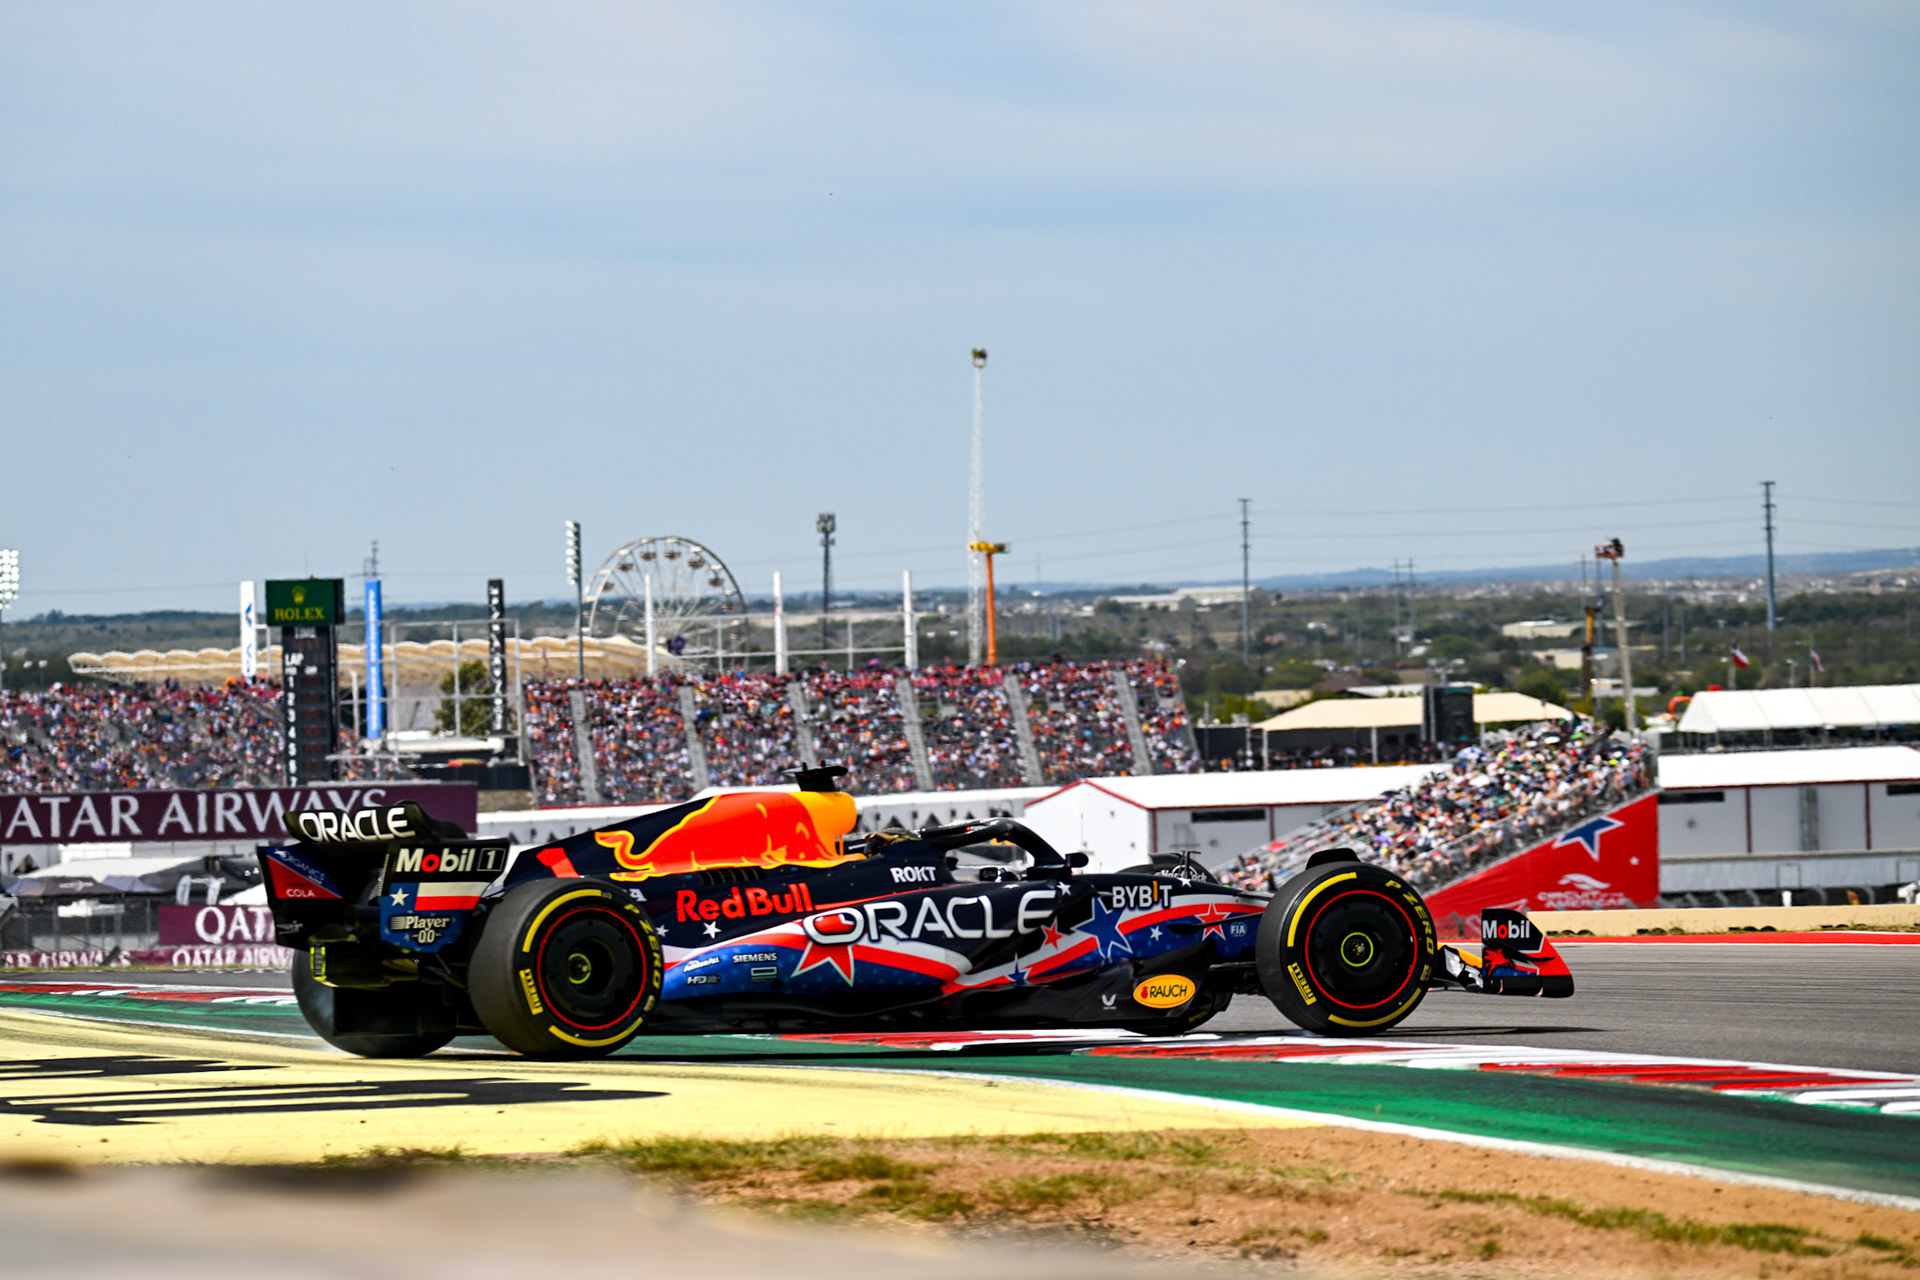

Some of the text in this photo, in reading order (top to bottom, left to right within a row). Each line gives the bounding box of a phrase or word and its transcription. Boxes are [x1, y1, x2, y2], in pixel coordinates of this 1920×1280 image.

[274, 607, 325, 621] ROLEX
[285, 652, 304, 666] LAP
[288, 726, 296, 739] 4
[0, 794, 142, 839] ATAR
[298, 807, 416, 842] ORACLE
[395, 847, 496, 873] Mobil 1
[890, 866, 937, 883] ROKT
[286, 888, 316, 898] COLA
[676, 882, 814, 922] Red Bull
[1112, 880, 1173, 908] BYBIT
[404, 916, 451, 930] Player
[803, 889, 1057, 944] ORACLE
[1385, 880, 1402, 889] P
[1402, 892, 1435, 956] ZERO
[1481, 919, 1530, 939] Mobil
[624, 903, 640, 914] P
[638, 919, 662, 990] ZERO
[732, 952, 778, 963] SIEMENS
[1149, 984, 1188, 998] RAUCH
[1287, 961, 1318, 1006] PIRELLI
